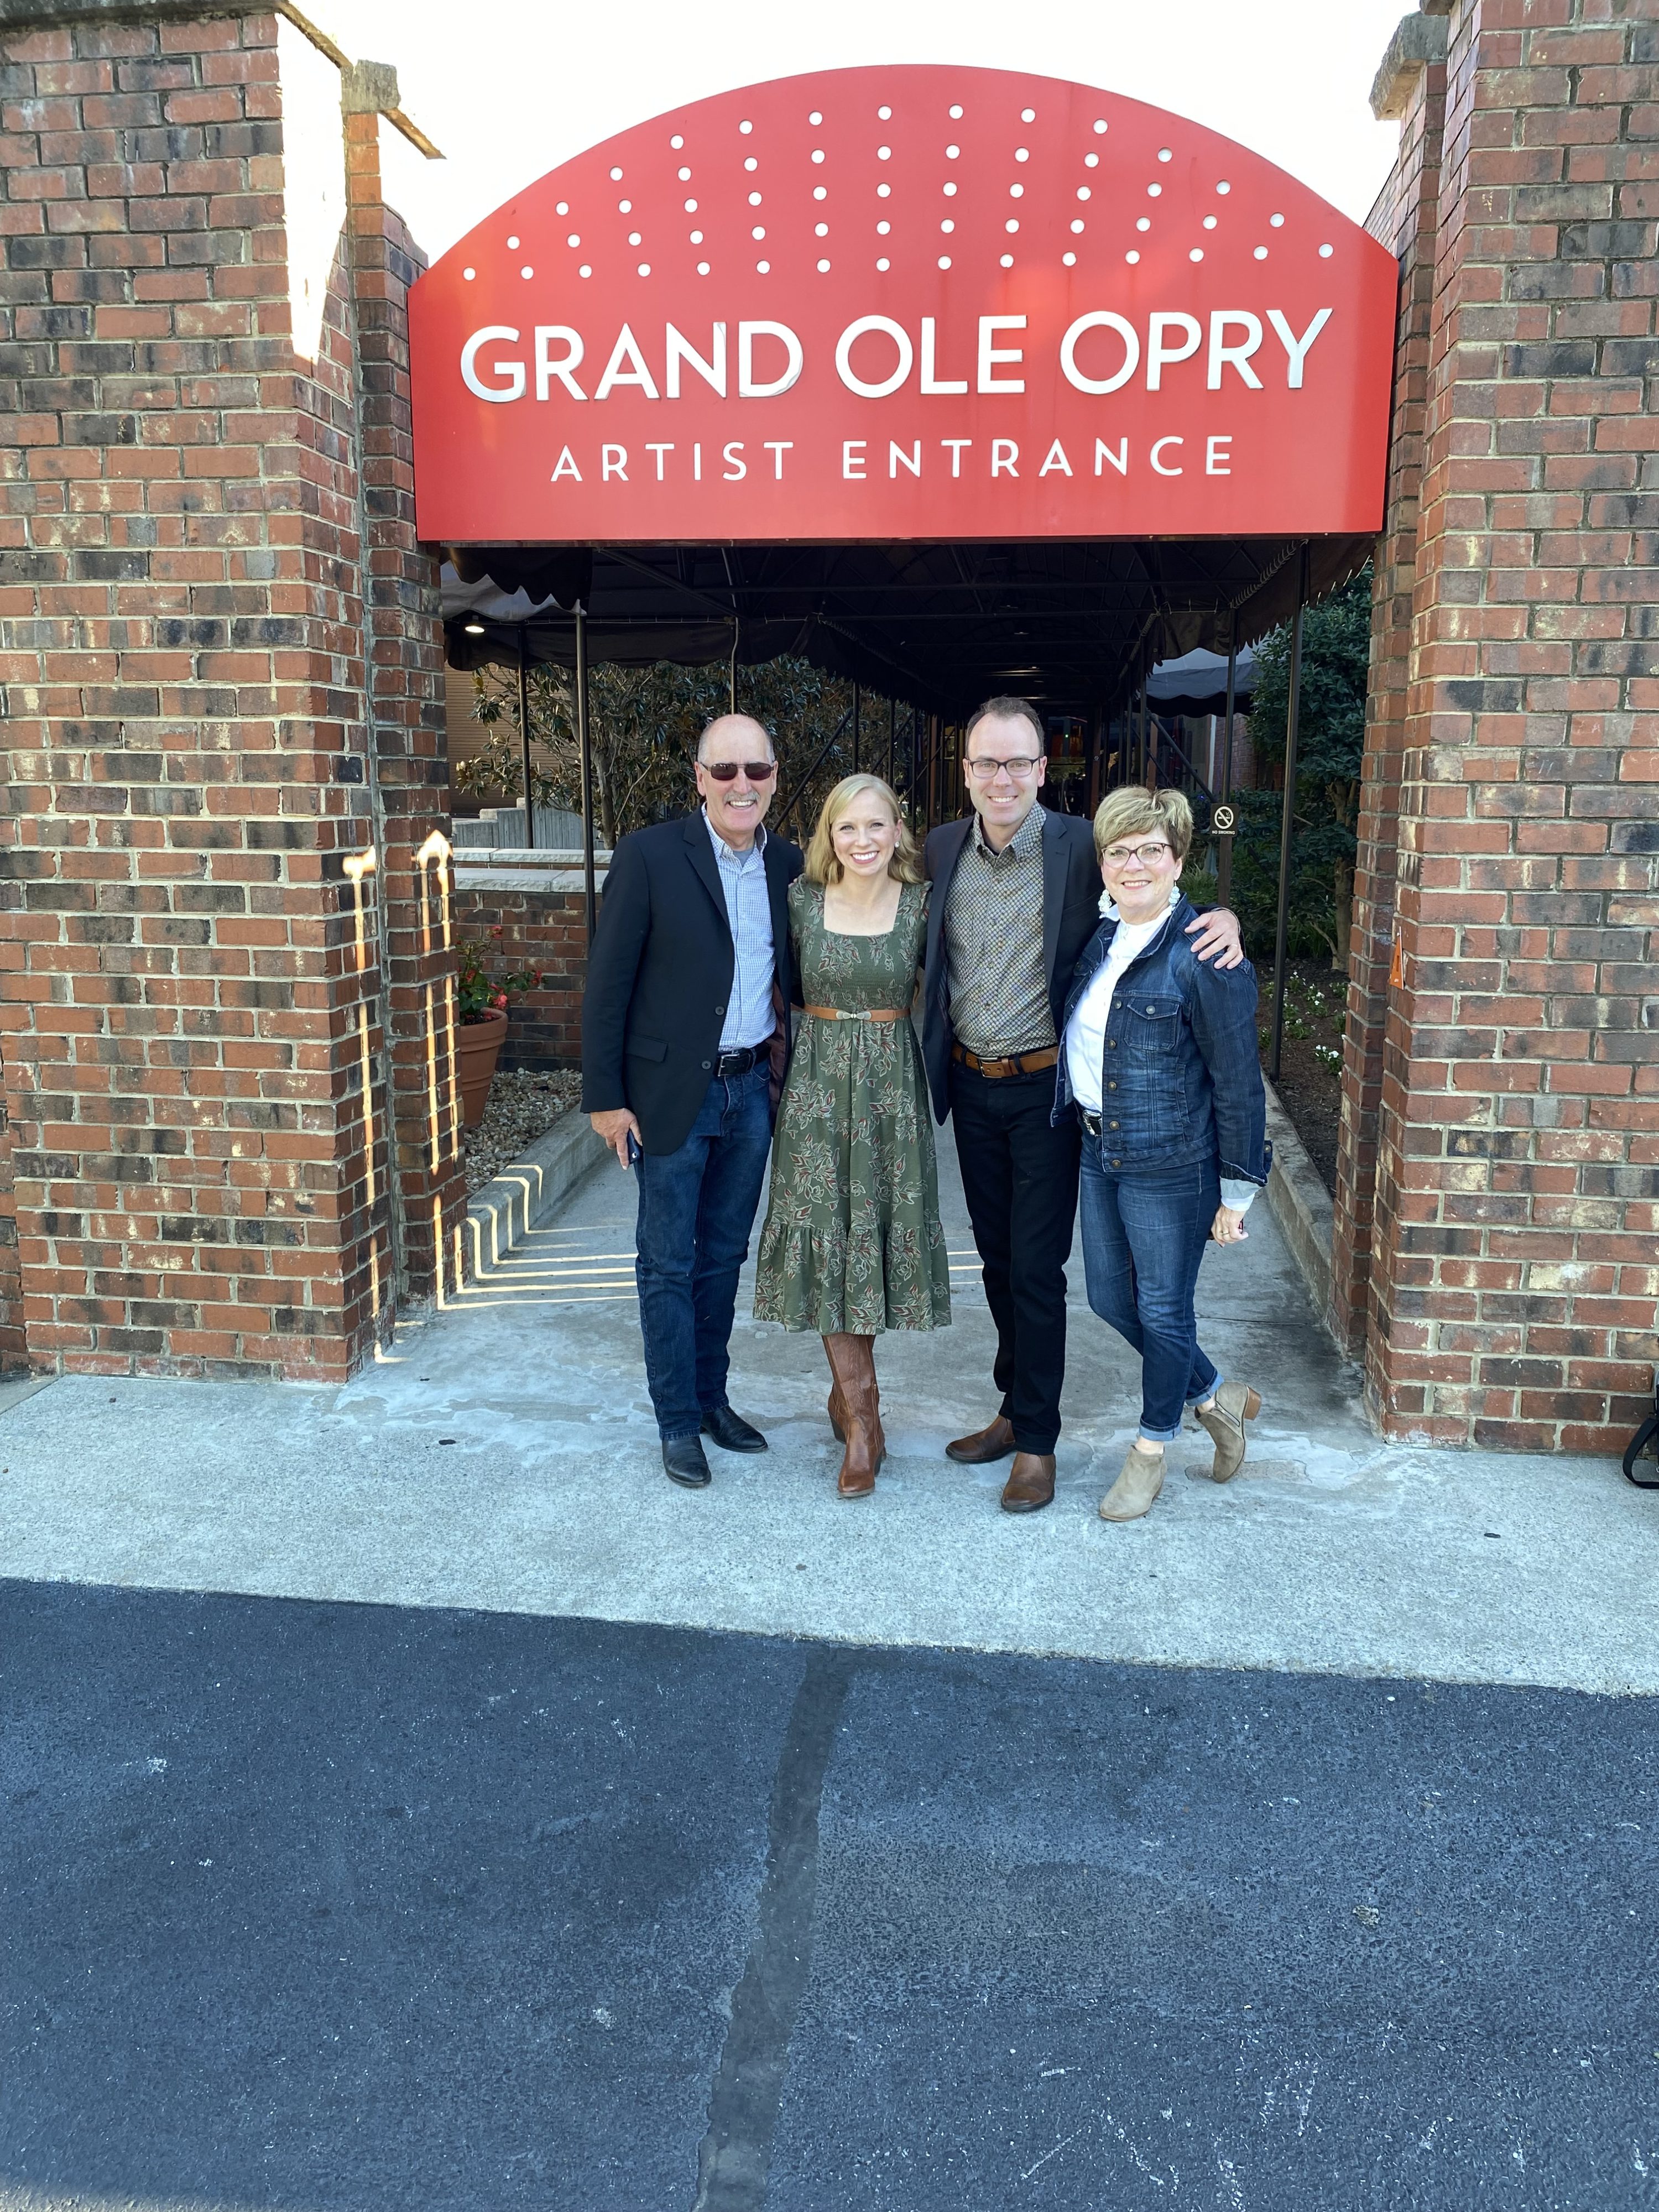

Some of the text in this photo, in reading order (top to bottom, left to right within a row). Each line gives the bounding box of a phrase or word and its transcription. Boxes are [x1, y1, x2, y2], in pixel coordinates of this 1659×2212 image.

[460, 307, 1333, 403] GRAND OLE OPRY
[550, 435, 1233, 482] ARTIST ENTRANCE
